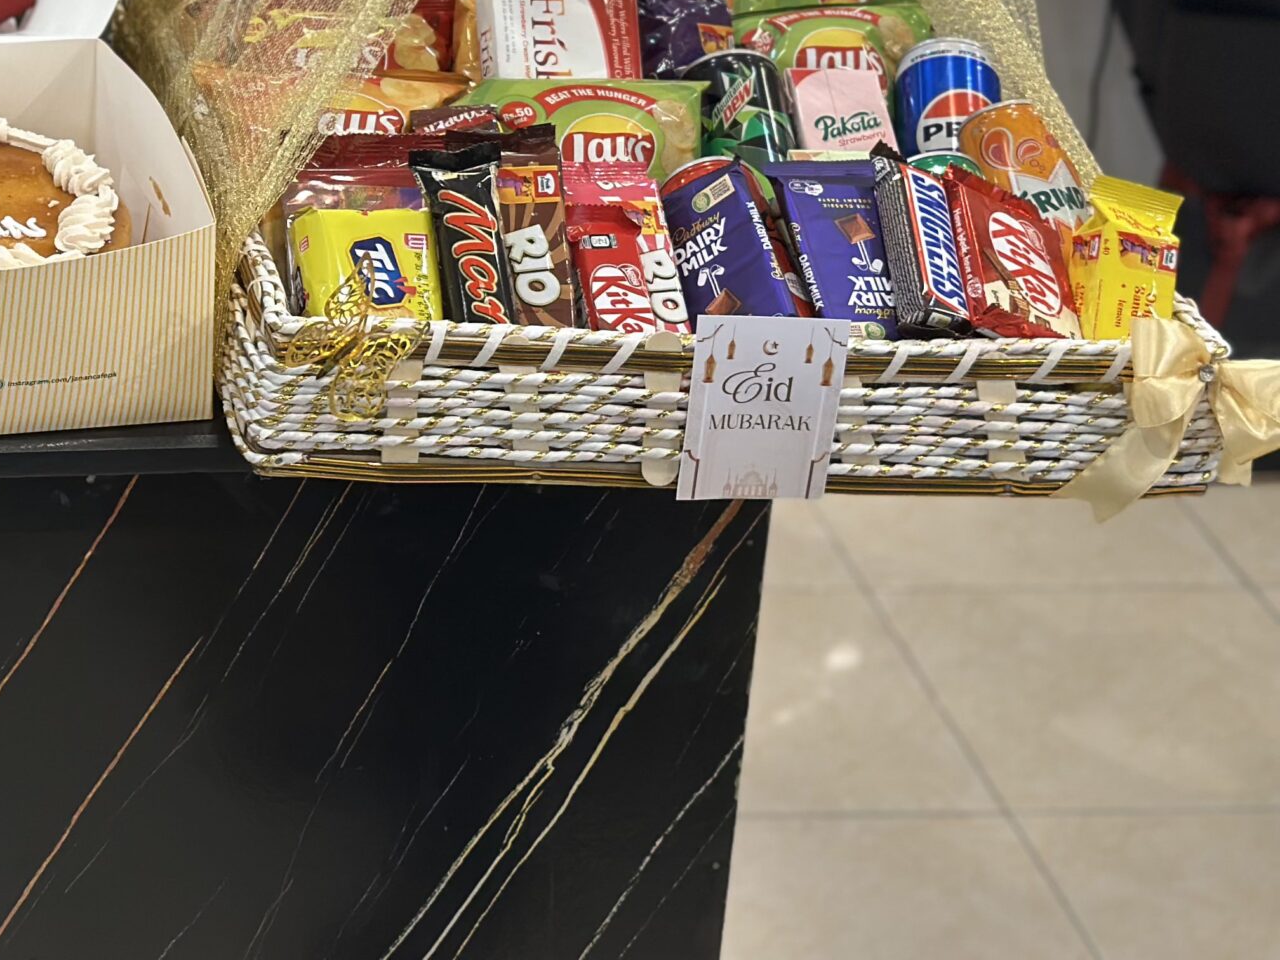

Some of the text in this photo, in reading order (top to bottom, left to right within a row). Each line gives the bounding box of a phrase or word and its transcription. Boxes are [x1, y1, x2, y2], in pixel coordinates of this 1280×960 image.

[503, 106, 534, 123] Rs.50
[545, 88, 648, 107] BEAT THE HUNGER
[838, 131, 886, 147] Strawberry
[672, 212, 720, 246] Cadbury
[673, 217, 726, 265] DAIRY
[911, 173, 968, 313] SNICKERS
[504, 224, 561, 307] RIO
[681, 238, 728, 277] MILK
[990, 217, 1059, 313] KitKat
[640, 249, 689, 323] RIO
[798, 253, 825, 311] DAIRY MILK
[722, 362, 794, 404] Eid
[709, 414, 812, 431] MUBARAK
